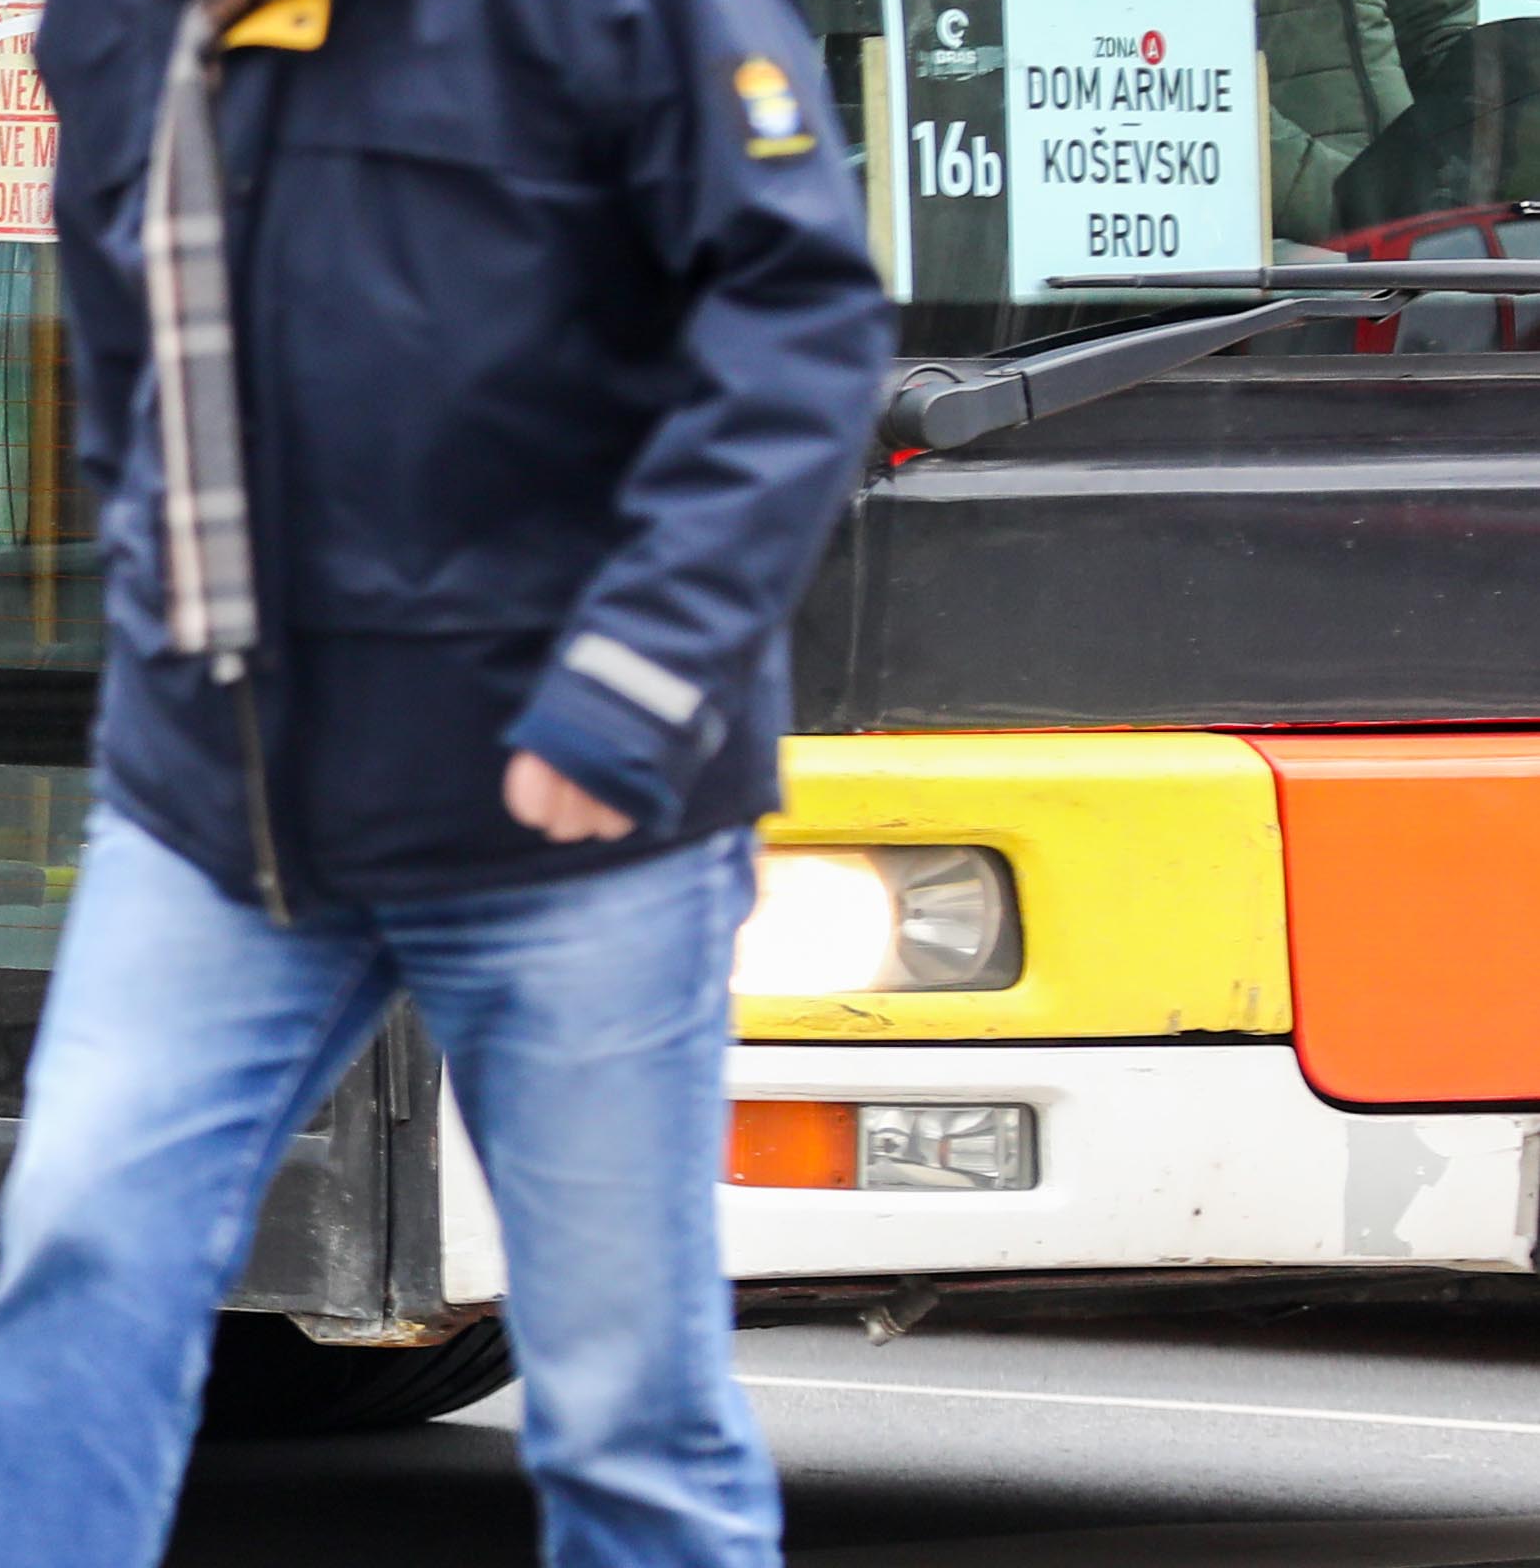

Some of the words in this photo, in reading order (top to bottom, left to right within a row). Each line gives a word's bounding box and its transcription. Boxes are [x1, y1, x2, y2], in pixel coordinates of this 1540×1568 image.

[1094, 36, 1139, 59] ZONA
[1027, 66, 1102, 111] DOM
[1110, 67, 1234, 113] ARMIJE
[33, 126, 58, 168] M
[911, 120, 1002, 199] 16b
[1042, 126, 1221, 186] KOŠEVSKO
[1088, 213, 1180, 258] BRDO
